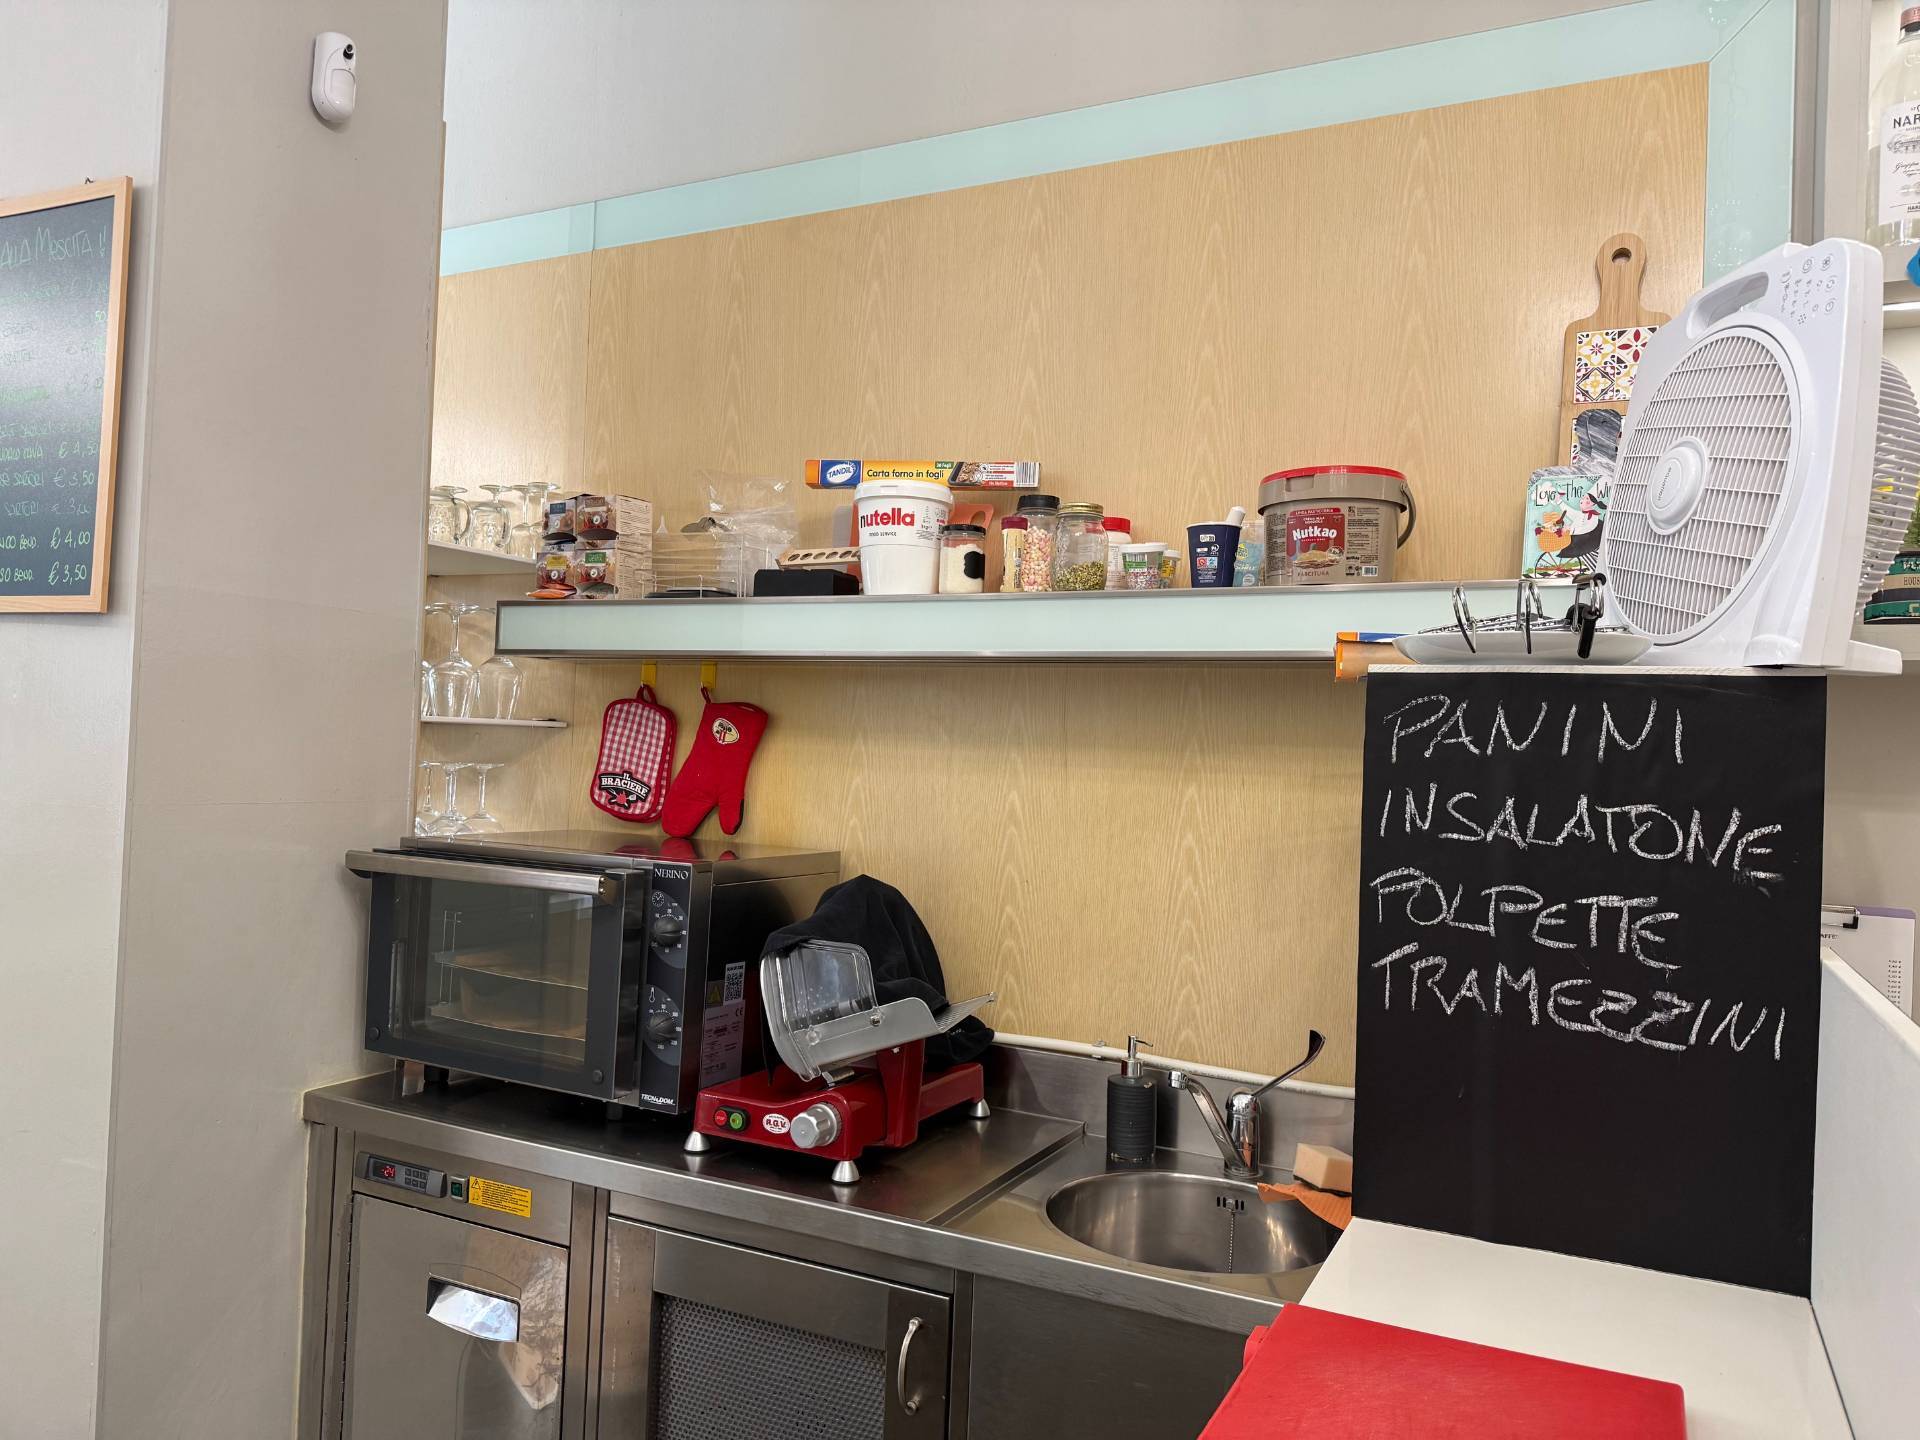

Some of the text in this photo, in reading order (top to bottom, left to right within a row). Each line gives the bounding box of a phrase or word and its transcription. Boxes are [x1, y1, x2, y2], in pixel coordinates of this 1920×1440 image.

[828, 466, 853, 479] TANDIL
[867, 469, 944, 480] Carta forno in fogli
[1535, 485, 1556, 506] Love
[1565, 481, 1584, 501] The
[860, 508, 915, 528] nutella
[51, 528, 61, 549] €
[64, 529, 91, 549] 4,00
[1292, 526, 1338, 541] Nutkao
[48, 561, 60, 585] €
[63, 564, 87, 585] 3,50
[1383, 694, 1684, 764] PANINI
[623, 772, 631, 780] IL
[601, 777, 648, 797] BRACIERE
[1380, 783, 1785, 880] INSALATONE
[654, 868, 689, 880] NERINO
[1370, 867, 1682, 969] POLPETTE
[1372, 942, 1785, 1061] TRAMEZZINI
